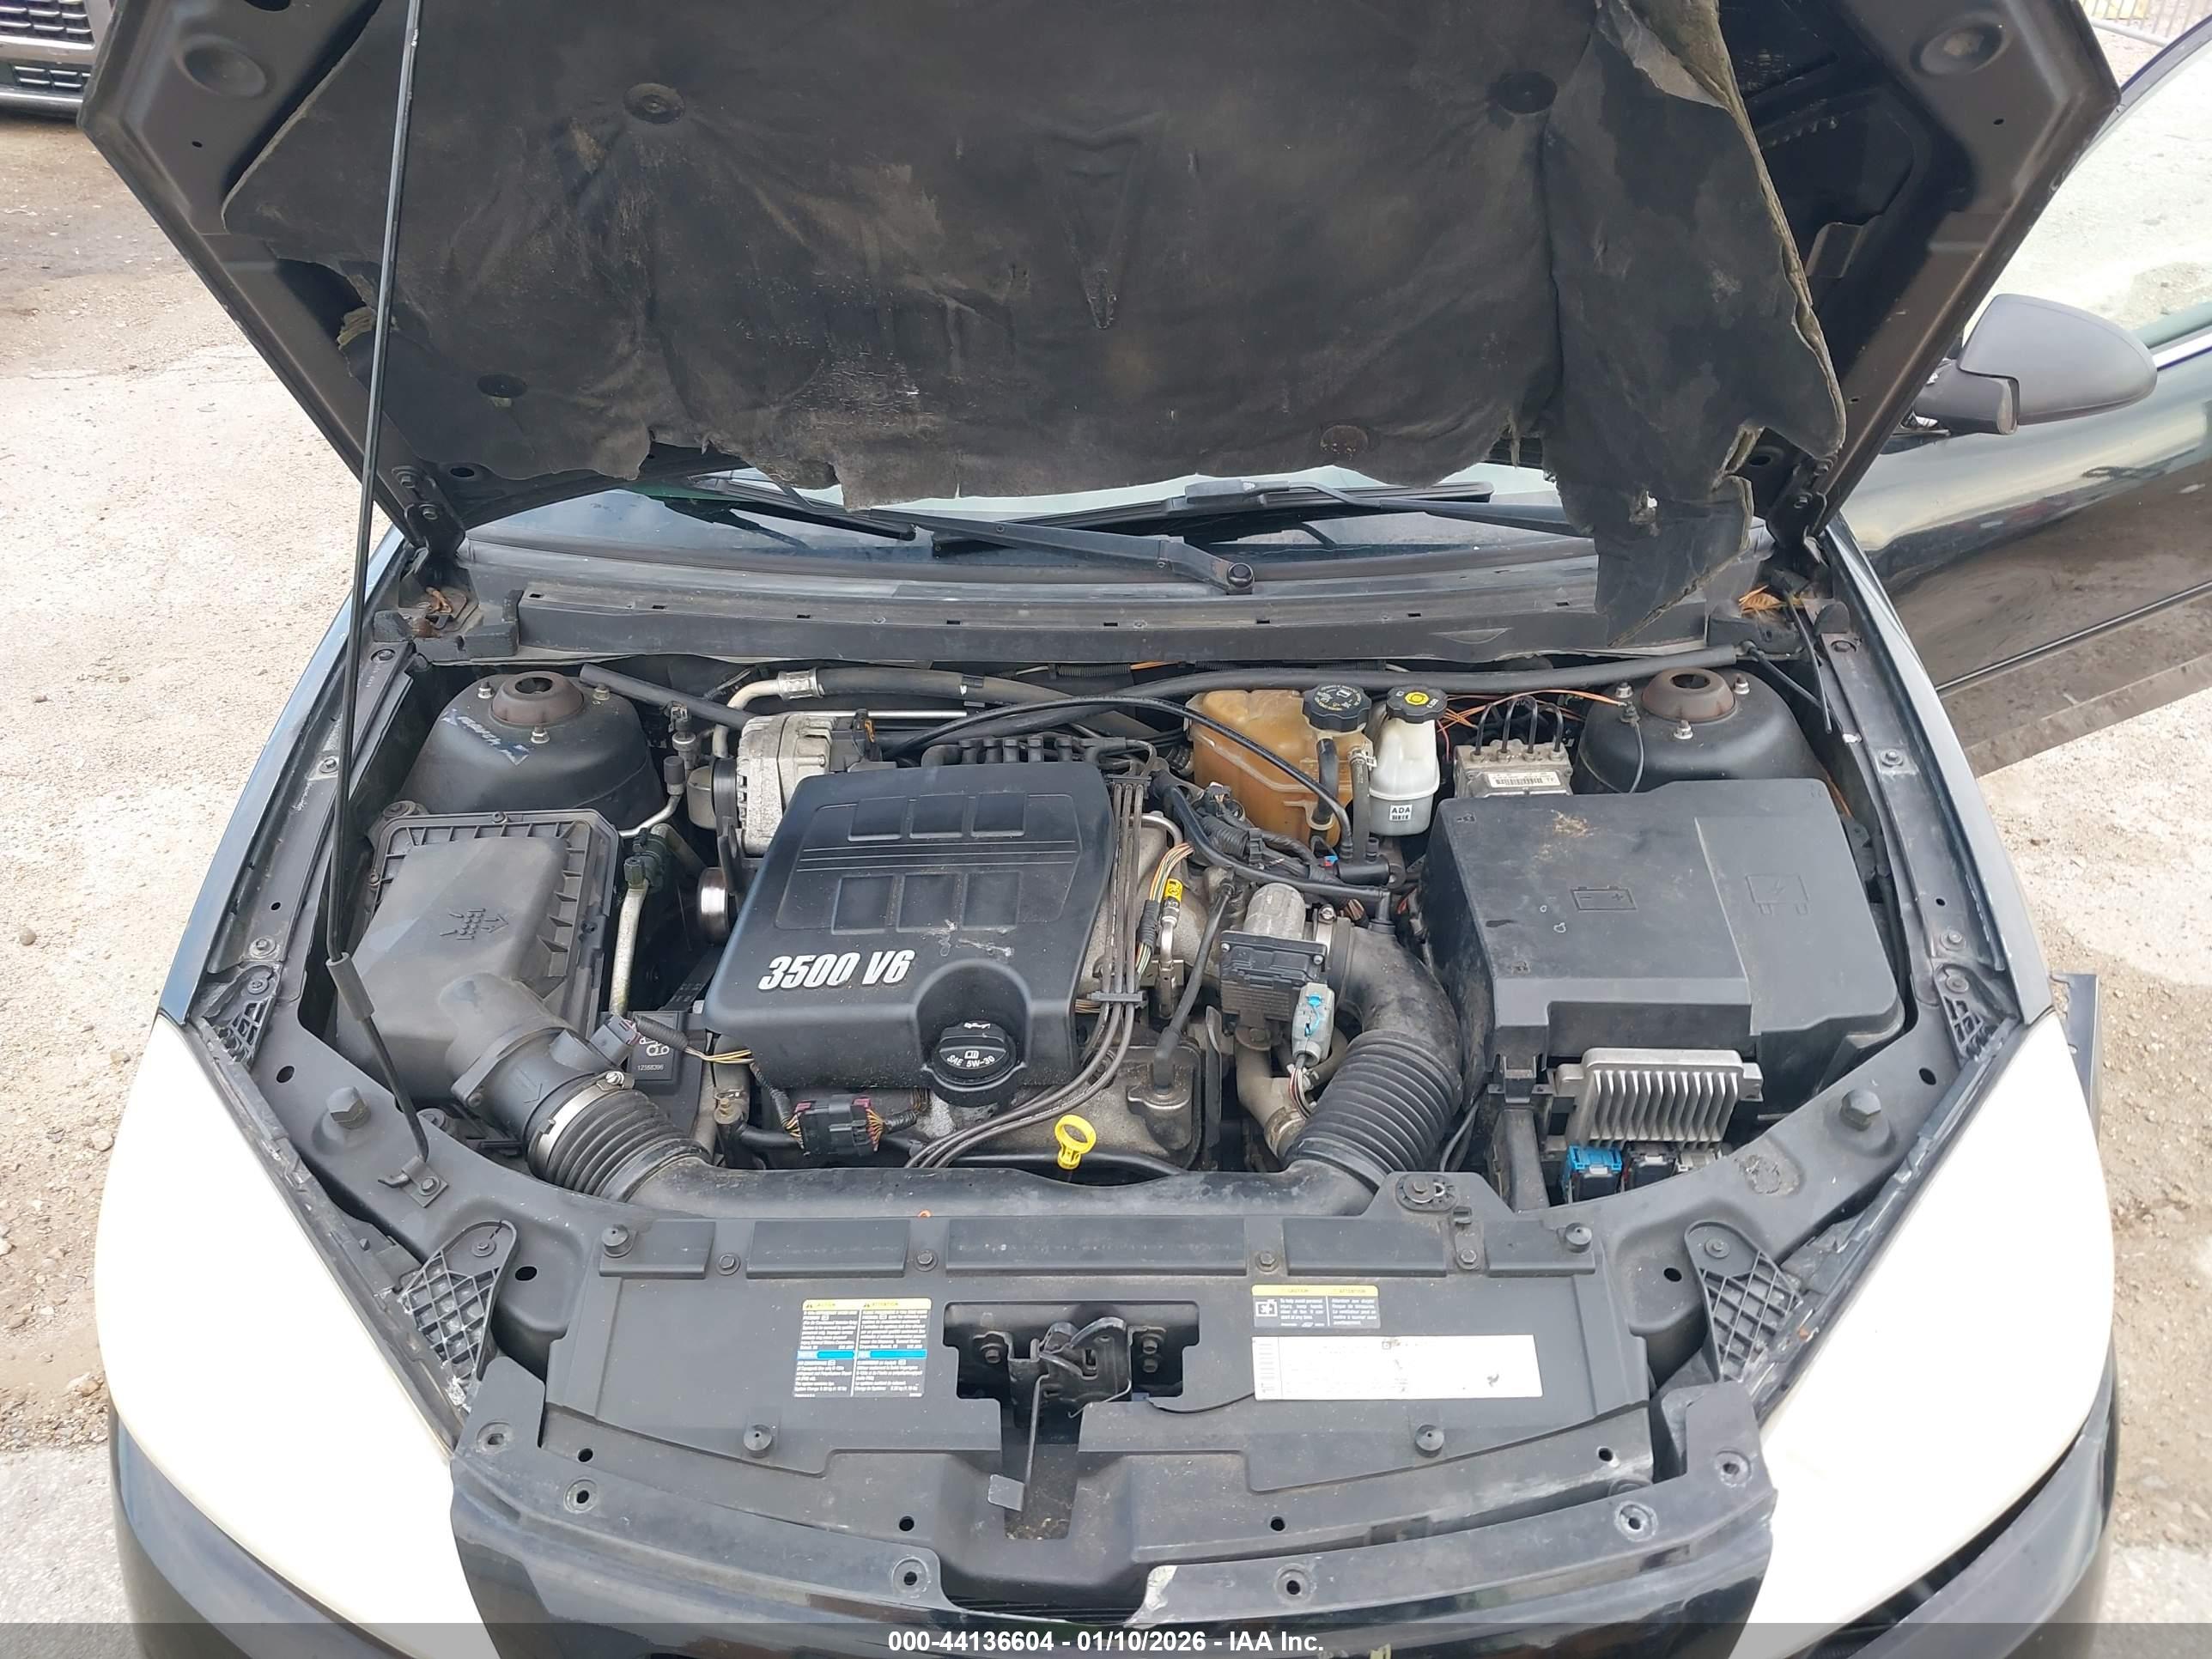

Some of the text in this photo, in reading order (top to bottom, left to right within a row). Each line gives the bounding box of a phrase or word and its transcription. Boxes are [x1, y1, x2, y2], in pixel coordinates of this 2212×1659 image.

[757, 949, 916, 991] 3500 V6
[946, 1054, 995, 1067] SAE 5W-30
